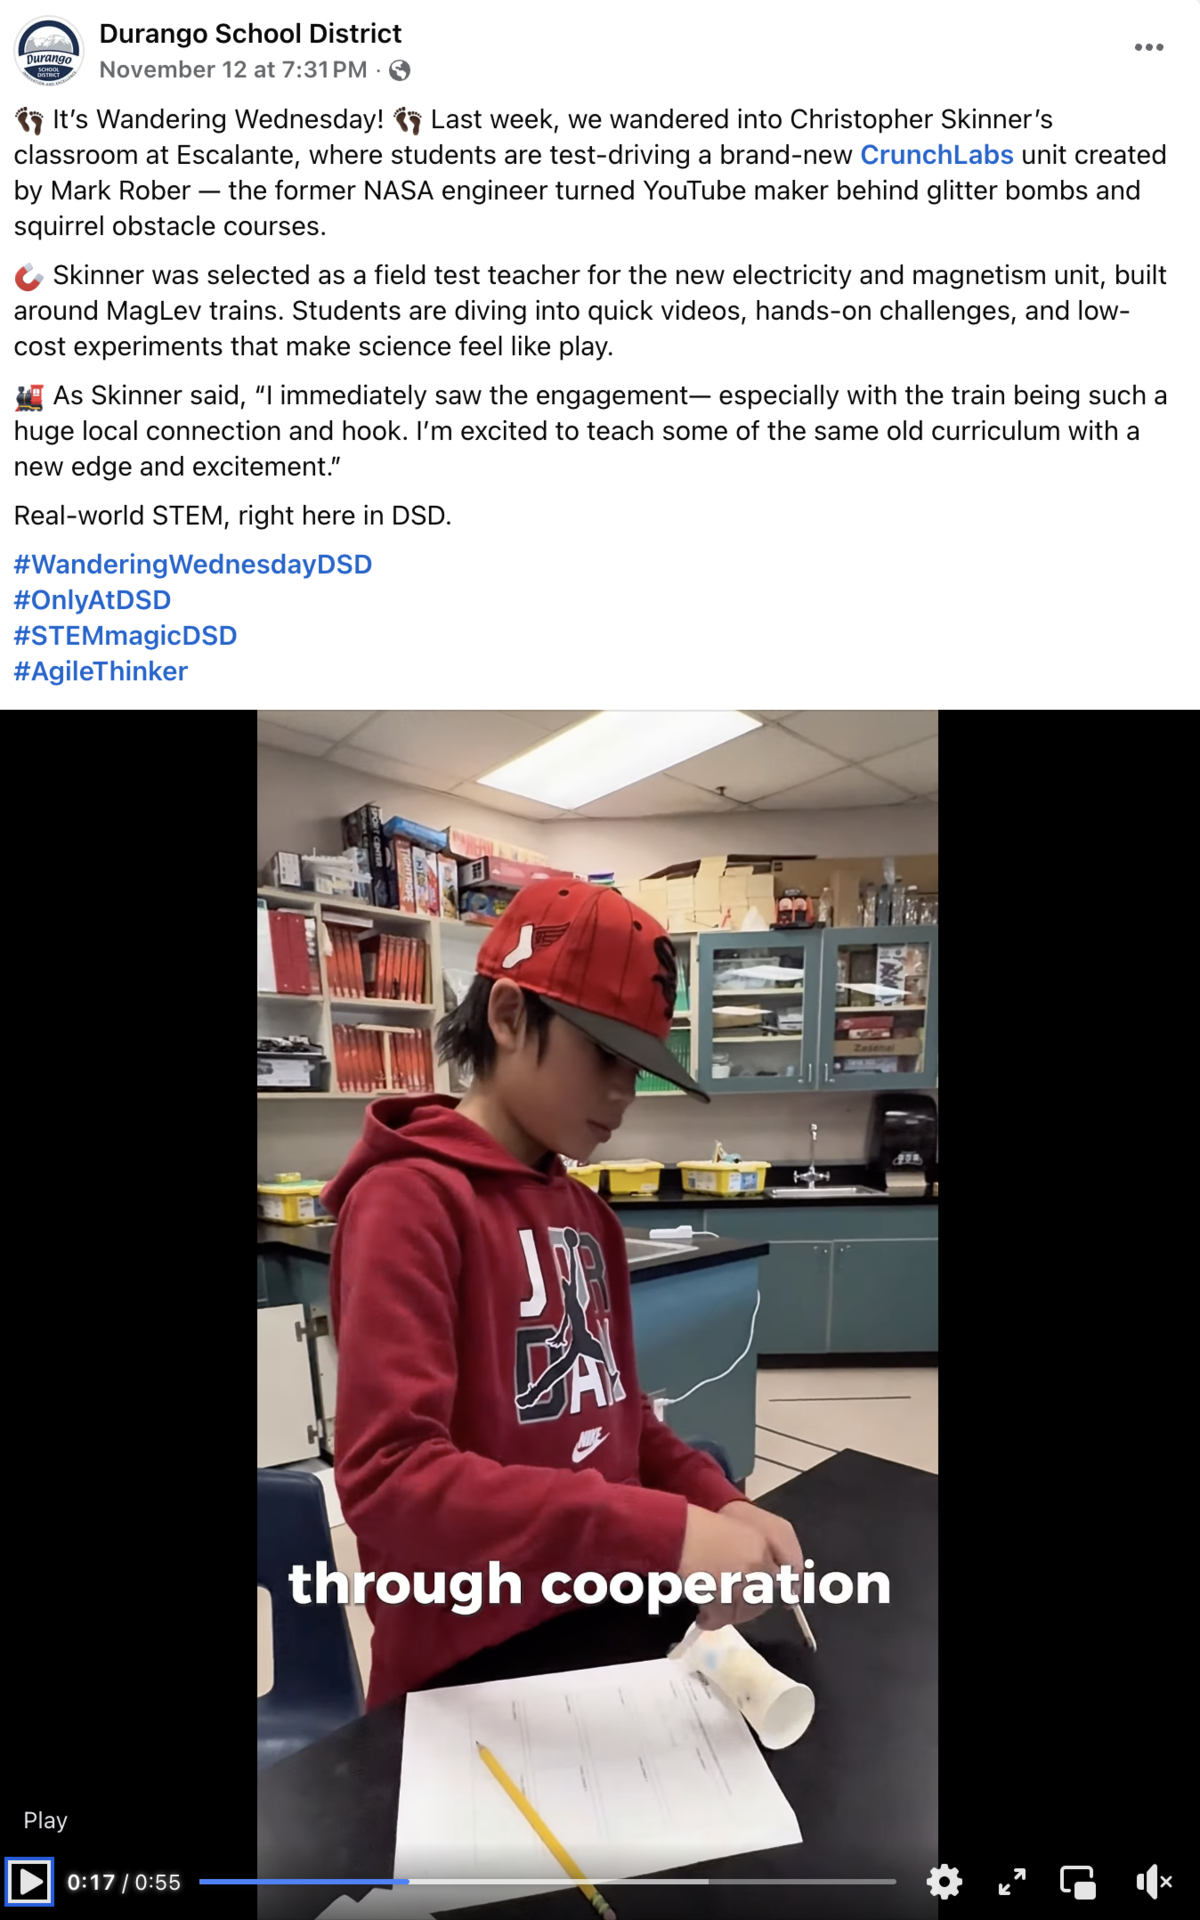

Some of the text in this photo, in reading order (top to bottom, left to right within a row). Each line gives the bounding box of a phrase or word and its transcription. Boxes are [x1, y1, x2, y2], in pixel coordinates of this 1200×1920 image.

[100, 21, 402, 49] Durango School District
[26, 54, 73, 65] Durango
[100, 59, 216, 79] November
[222, 60, 247, 78] 12
[254, 61, 276, 78] at
[54, 107, 1053, 134] It’s Wandering Wednesday! Last week, we wandered into Christopher Skinner’s
[14, 143, 1166, 170] classroom at Escalante, where students are test-driving a brand-new CrunchLabs unit created
[14, 179, 43, 206] by
[51, 179, 111, 201] Mark
[119, 179, 192, 201] Rober
[228, 179, 267, 201] the
[274, 179, 357, 201] former
[364, 179, 434, 201] NASA
[441, 179, 549, 206] engineer
[554, 179, 635, 201] turned
[643, 179, 746, 201] YouTube
[754, 179, 829, 201] maker
[837, 179, 918, 201] behind
[927, 179, 999, 206] glitter
[1006, 179, 1088, 201] bombs
[1096, 179, 1140, 201] and
[14, 214, 326, 241] squirrel obstacle courses.
[53, 263, 1167, 290] Skinner was selected as a field test teacher for the new electricity and magnetism unit, built
[14, 299, 1130, 326] around MagLev trains. Students are diving into quick videos, hands-on challenges, and low-
[14, 334, 613, 361] cost experiments that make science feel like play.
[52, 384, 84, 406] As
[91, 383, 183, 406] Skinner
[190, 383, 246, 410] said,
[255, 384, 272, 405] “I
[281, 383, 427, 410] immediately
[435, 389, 482, 406] saw
[489, 384, 528, 406] the
[719, 383, 840, 410] especially
[846, 383, 897, 405] with
[904, 384, 944, 406] the
[951, 383, 1005, 406] train
[1014, 383, 1080, 410] being
[1088, 384, 1146, 406] such
[1154, 389, 1167, 406] a
[14, 419, 1140, 446] huge local connection and hook. I’m excited to teach some of the same old curriculum with a
[14, 455, 341, 482] new edge and excitement.”
[15, 504, 451, 531] Real-world STEM, right here in DSD.
[13, 552, 372, 580] #WanderingWednesdayDSD
[13, 588, 171, 615] #OnlyAtDSD
[13, 623, 237, 651] #STEMmagicDSD
[13, 659, 189, 686] #AgileThinker
[370, 806, 383, 867] SPORT CENTER
[400, 847, 414, 903] TIGHTROPE
